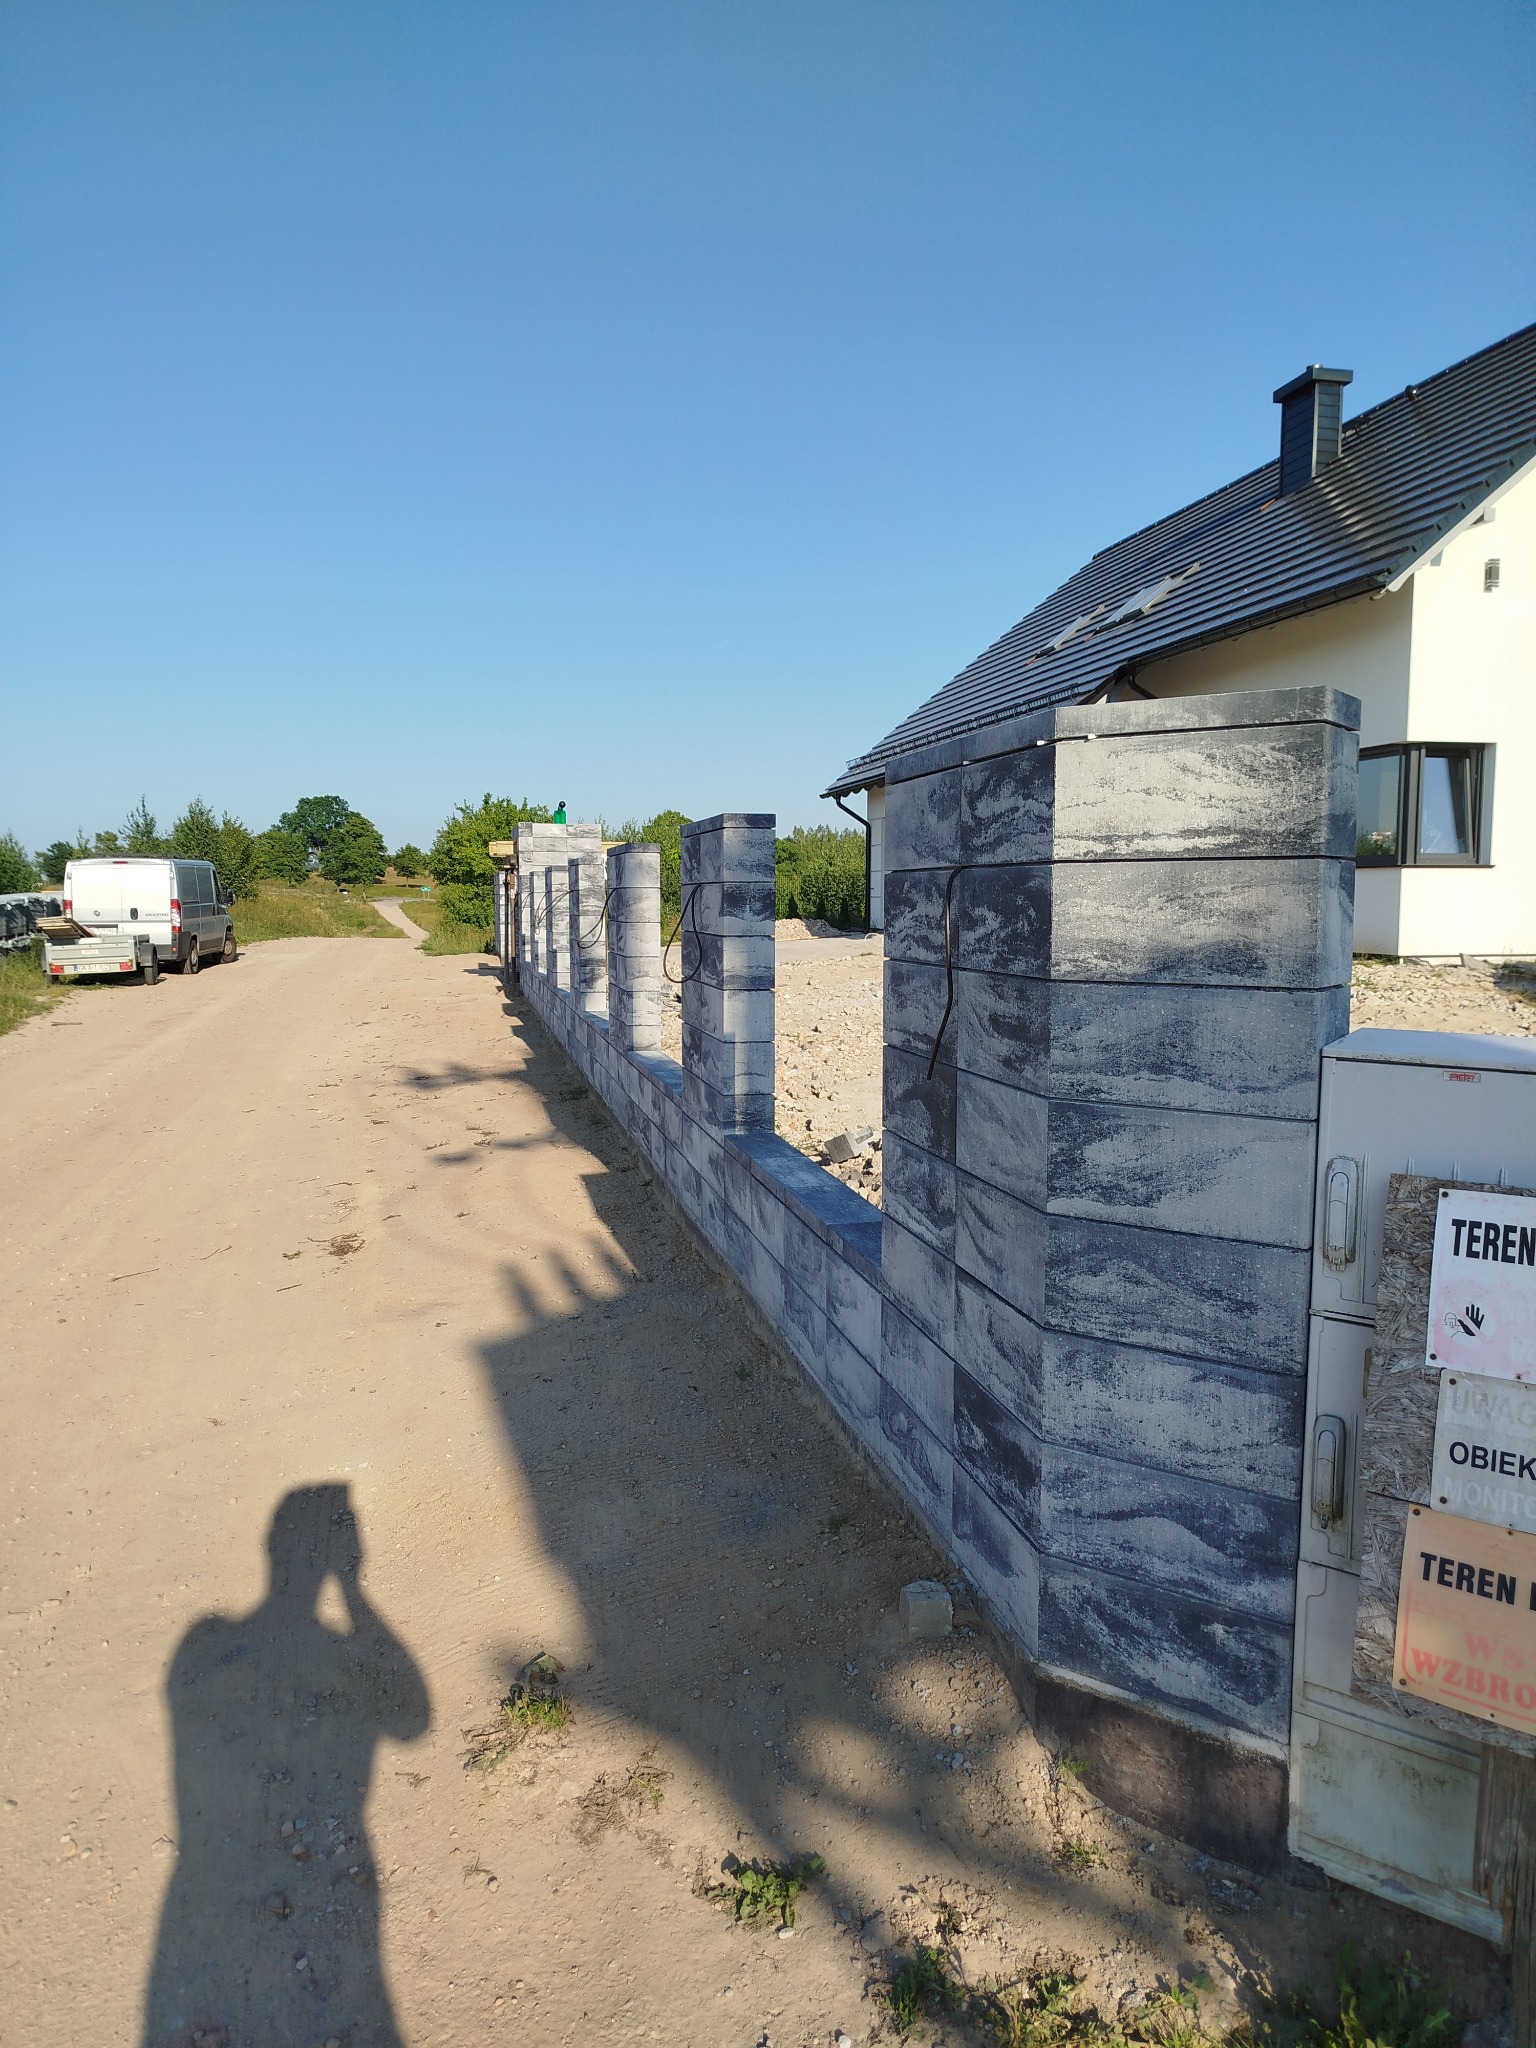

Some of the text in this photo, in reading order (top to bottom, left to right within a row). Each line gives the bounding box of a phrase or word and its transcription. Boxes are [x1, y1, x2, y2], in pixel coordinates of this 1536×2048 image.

[1451, 1219, 1536, 1267] TEREN
[1449, 1441, 1536, 1480] OBIEK
[1420, 1551, 1516, 1605] TEREN
[1411, 1647, 1536, 1710] WZBRO
